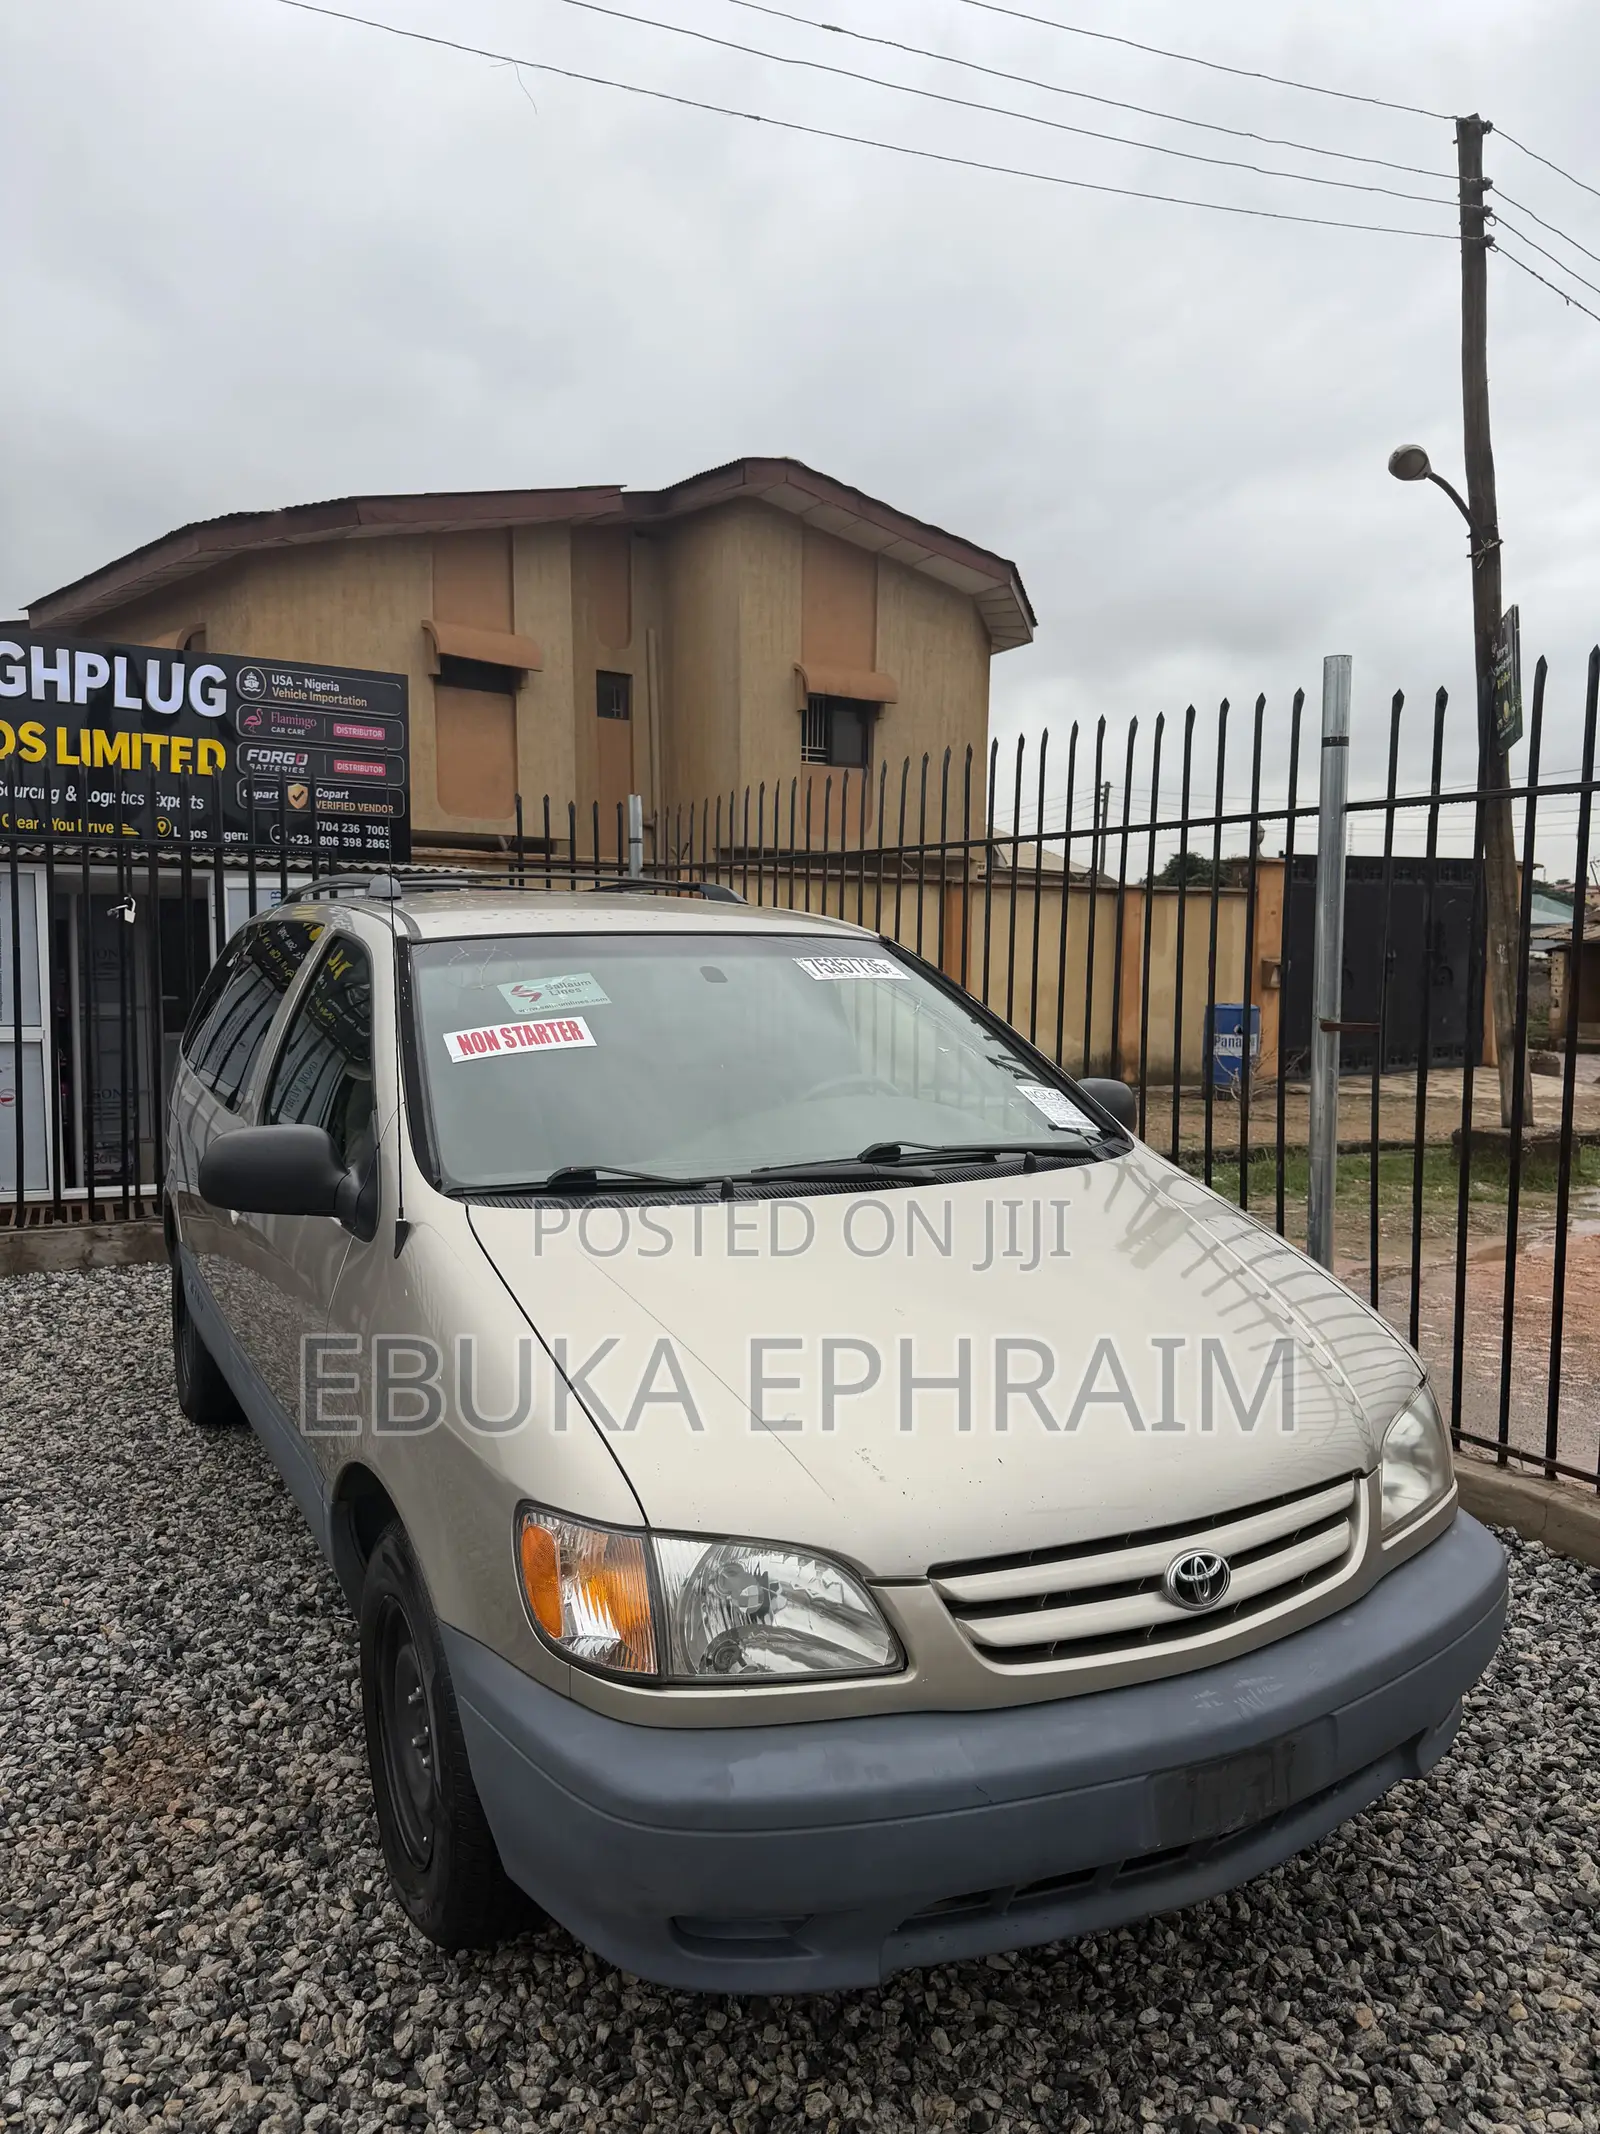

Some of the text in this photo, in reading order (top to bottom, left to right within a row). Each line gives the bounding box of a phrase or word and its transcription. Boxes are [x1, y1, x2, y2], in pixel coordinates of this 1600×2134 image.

[0, 641, 227, 717] GHPLUG
[272, 674, 293, 686] USA
[304, 678, 340, 692] Nigeria
[272, 687, 367, 707] Vehicle Importation
[270, 711, 317, 729] Flamingo
[270, 726, 306, 736] CAR CARE
[336, 726, 383, 738] DISTRIBUTOR
[56, 726, 226, 776] LIMITED
[246, 749, 309, 766] FORGO
[336, 763, 383, 774] DISTRIBUTOR
[65, 785, 77, 802] &
[315, 788, 350, 800] Copart
[315, 800, 394, 814] VERIFIED VENDOR
[52, 817, 75, 832] You
[341, 823, 360, 834] 236
[365, 825, 389, 836] 7003
[319, 836, 339, 847] 806
[342, 837, 362, 847] 398
[365, 838, 391, 849] 2863
[803, 958, 889, 975] 75357735
[549, 987, 582, 996] Lines
[457, 1019, 585, 1056] NON STARTER
